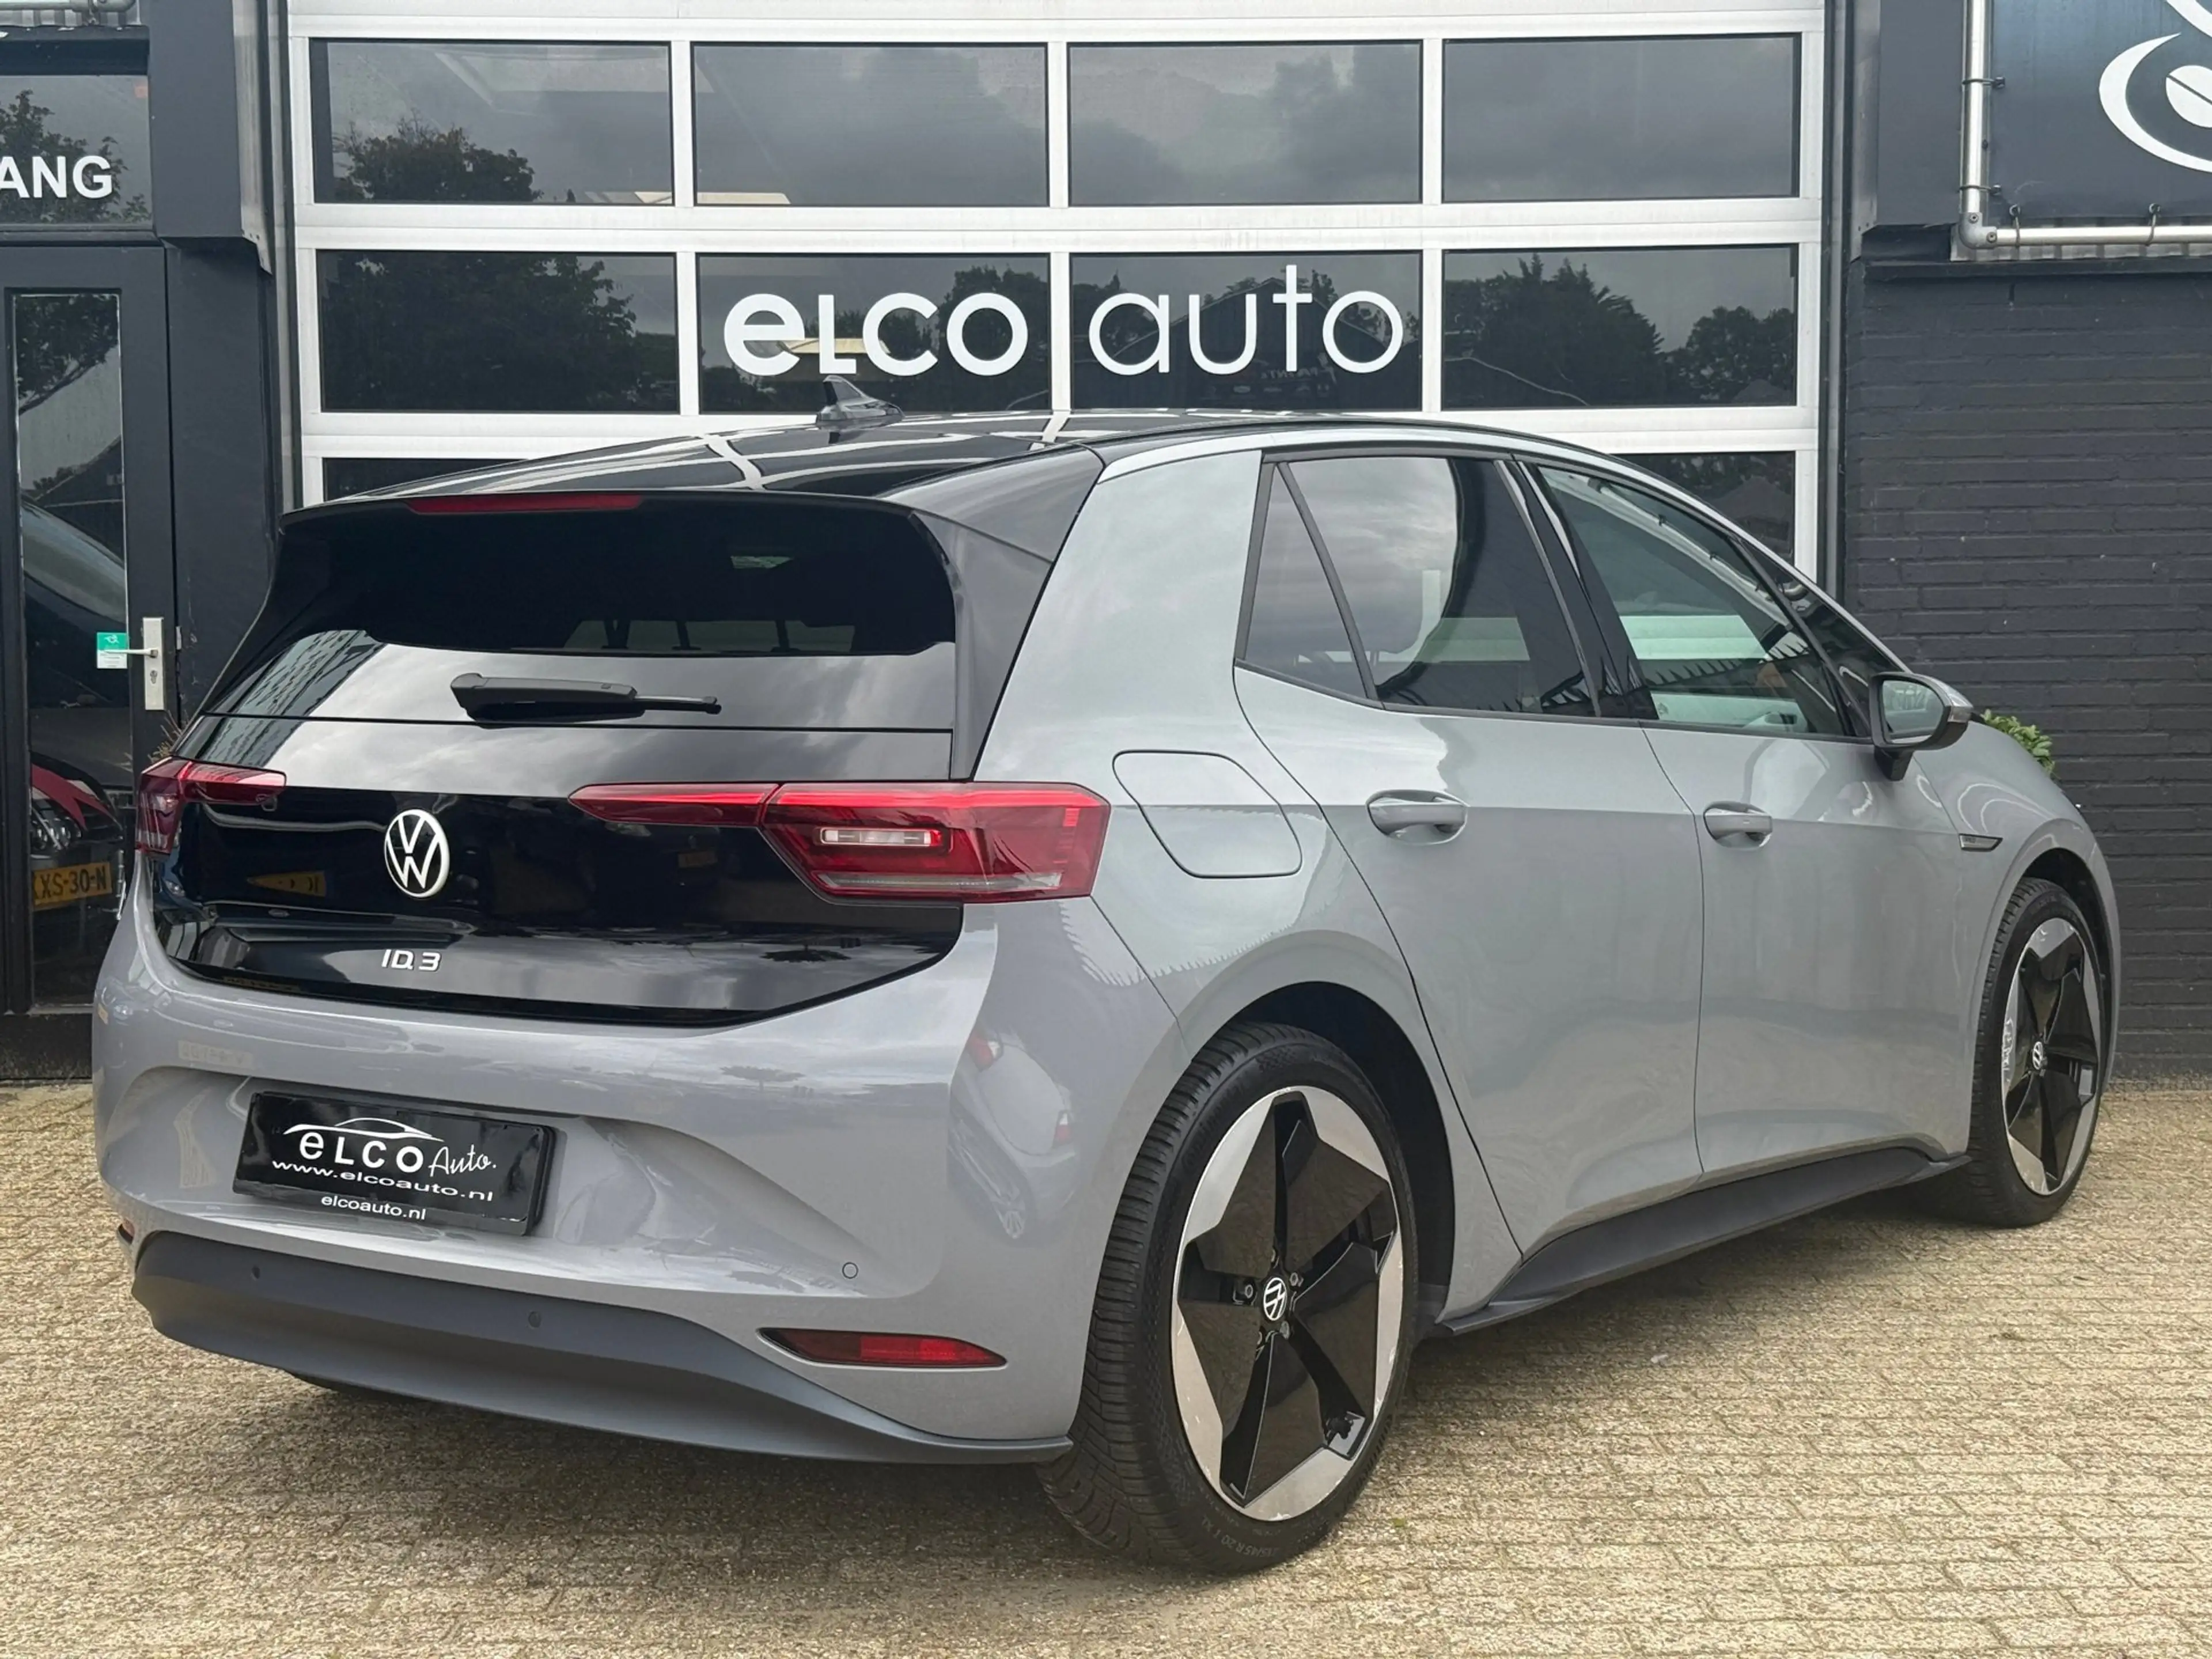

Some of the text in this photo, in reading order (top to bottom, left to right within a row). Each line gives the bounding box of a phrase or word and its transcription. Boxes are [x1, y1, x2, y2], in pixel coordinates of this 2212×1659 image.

[0, 156, 113, 199] ANG
[1088, 264, 1404, 376] auto
[272, 1161, 493, 1202] www.elcoauto.nl
[321, 1195, 426, 1220] elcoauto.nl
